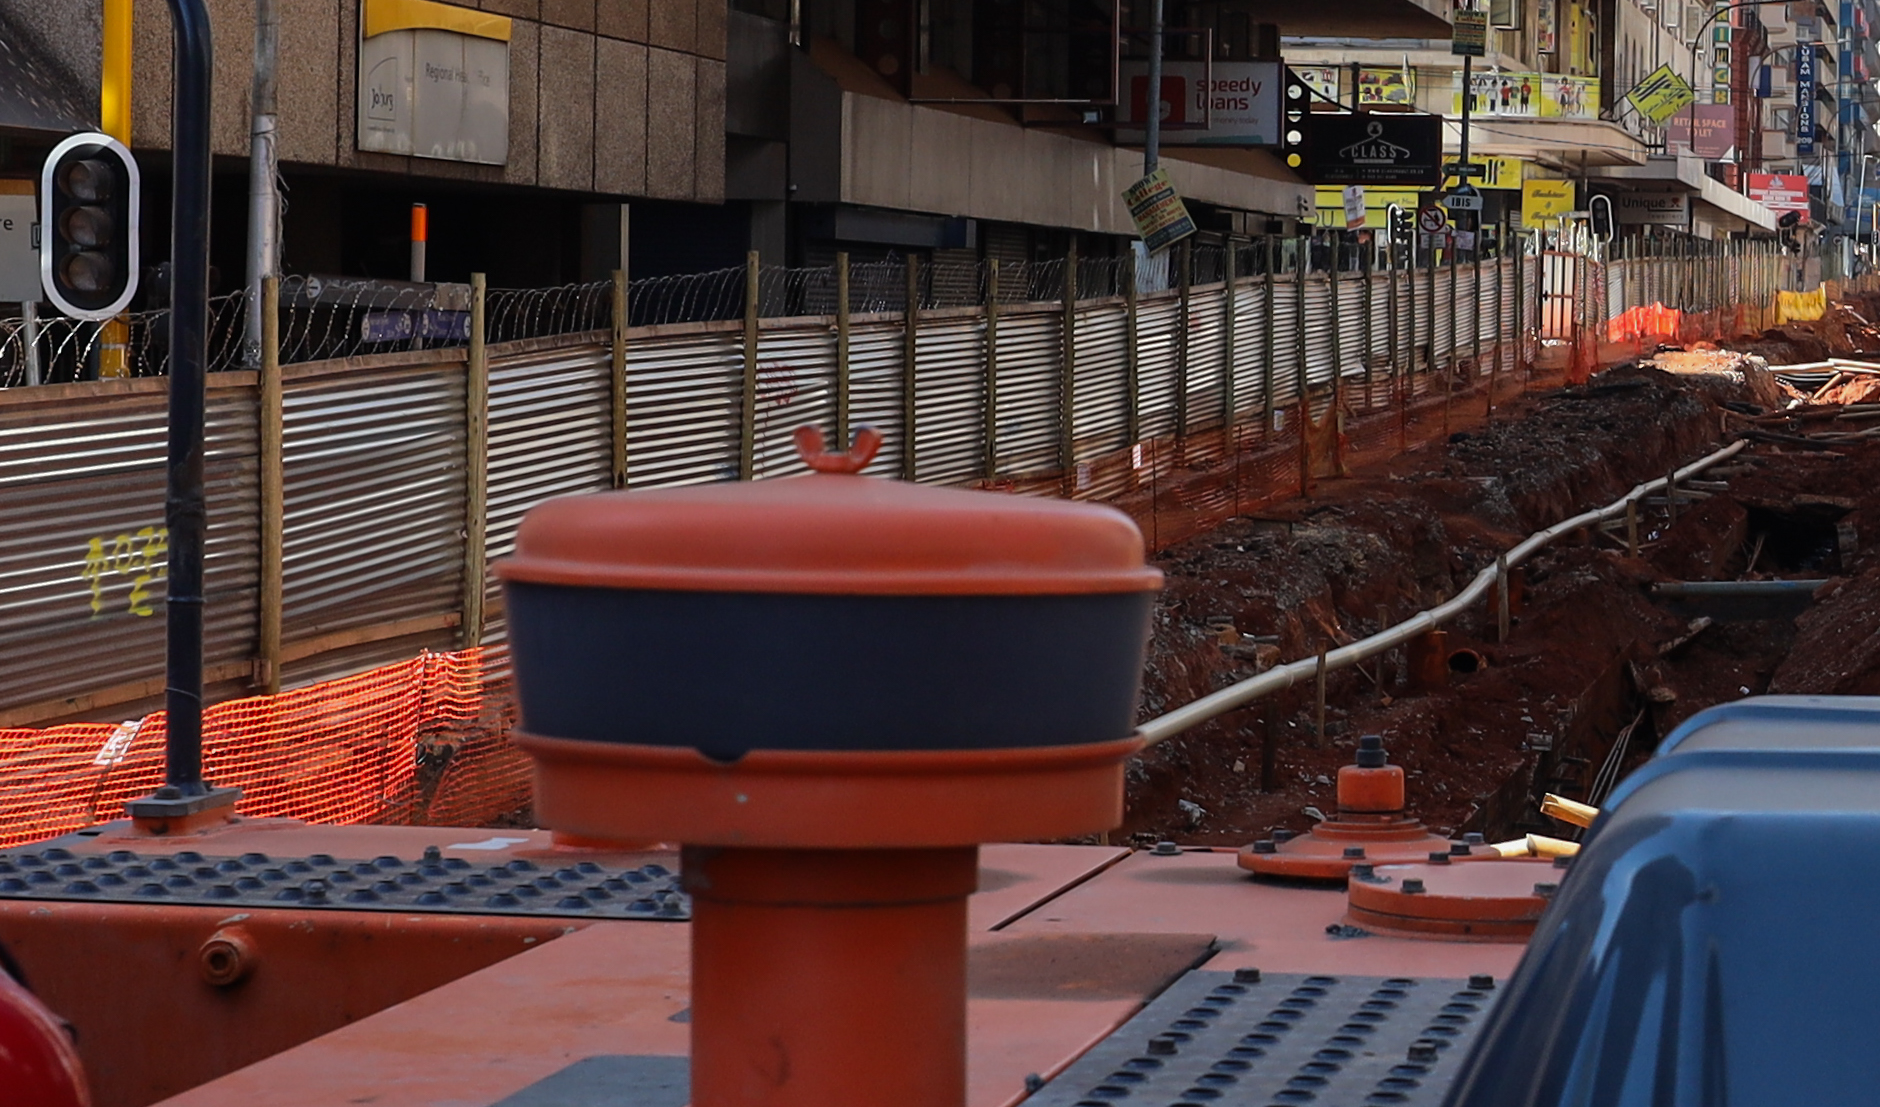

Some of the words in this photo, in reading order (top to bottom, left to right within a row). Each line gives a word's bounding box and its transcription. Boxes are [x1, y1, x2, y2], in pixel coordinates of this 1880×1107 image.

[425, 61, 454, 84] Regional
[1799, 81, 1811, 133] MANSIONS
[1673, 117, 1700, 127] RETIL
[1701, 118, 1727, 128] SPACE
[1699, 128, 1713, 138] LET
[1351, 145, 1397, 158] CLASS
[1451, 197, 1471, 207] IBIS
[1621, 196, 1666, 212] Unique
